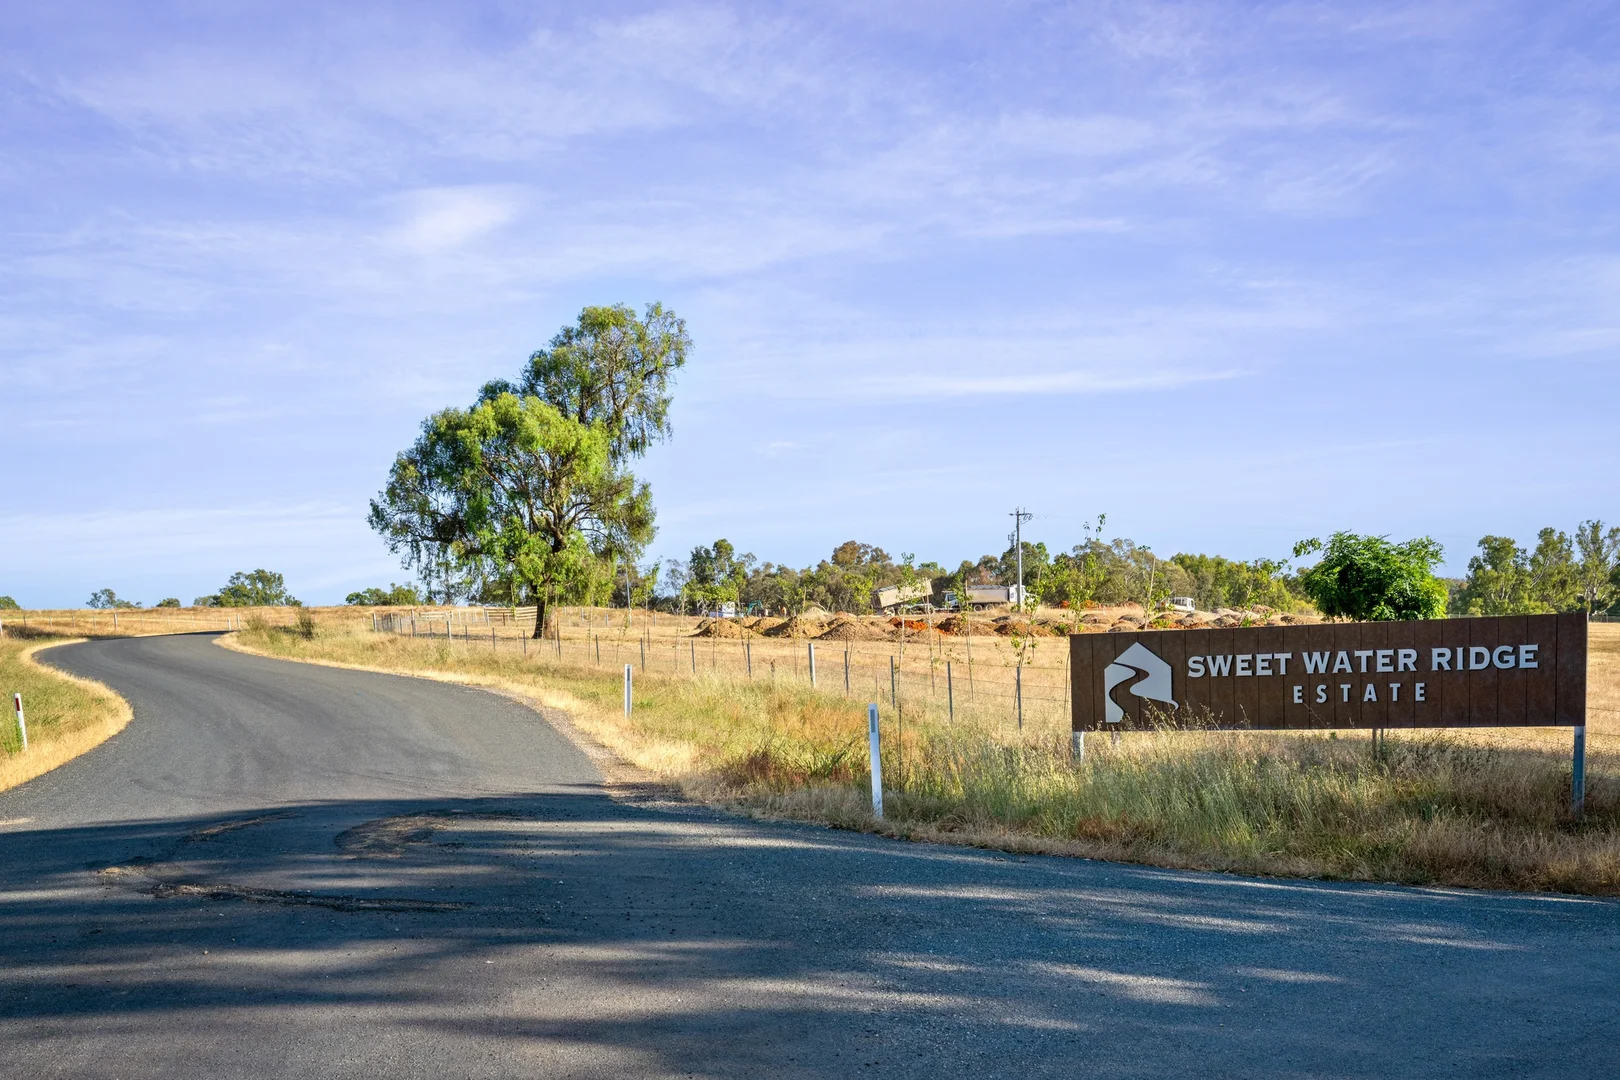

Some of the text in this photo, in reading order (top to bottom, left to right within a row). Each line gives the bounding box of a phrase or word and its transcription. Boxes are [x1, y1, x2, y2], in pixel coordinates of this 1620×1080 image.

[1187, 644, 1539, 678] SWEET WATER RIDGE
[1293, 682, 1426, 704] ESTATE
